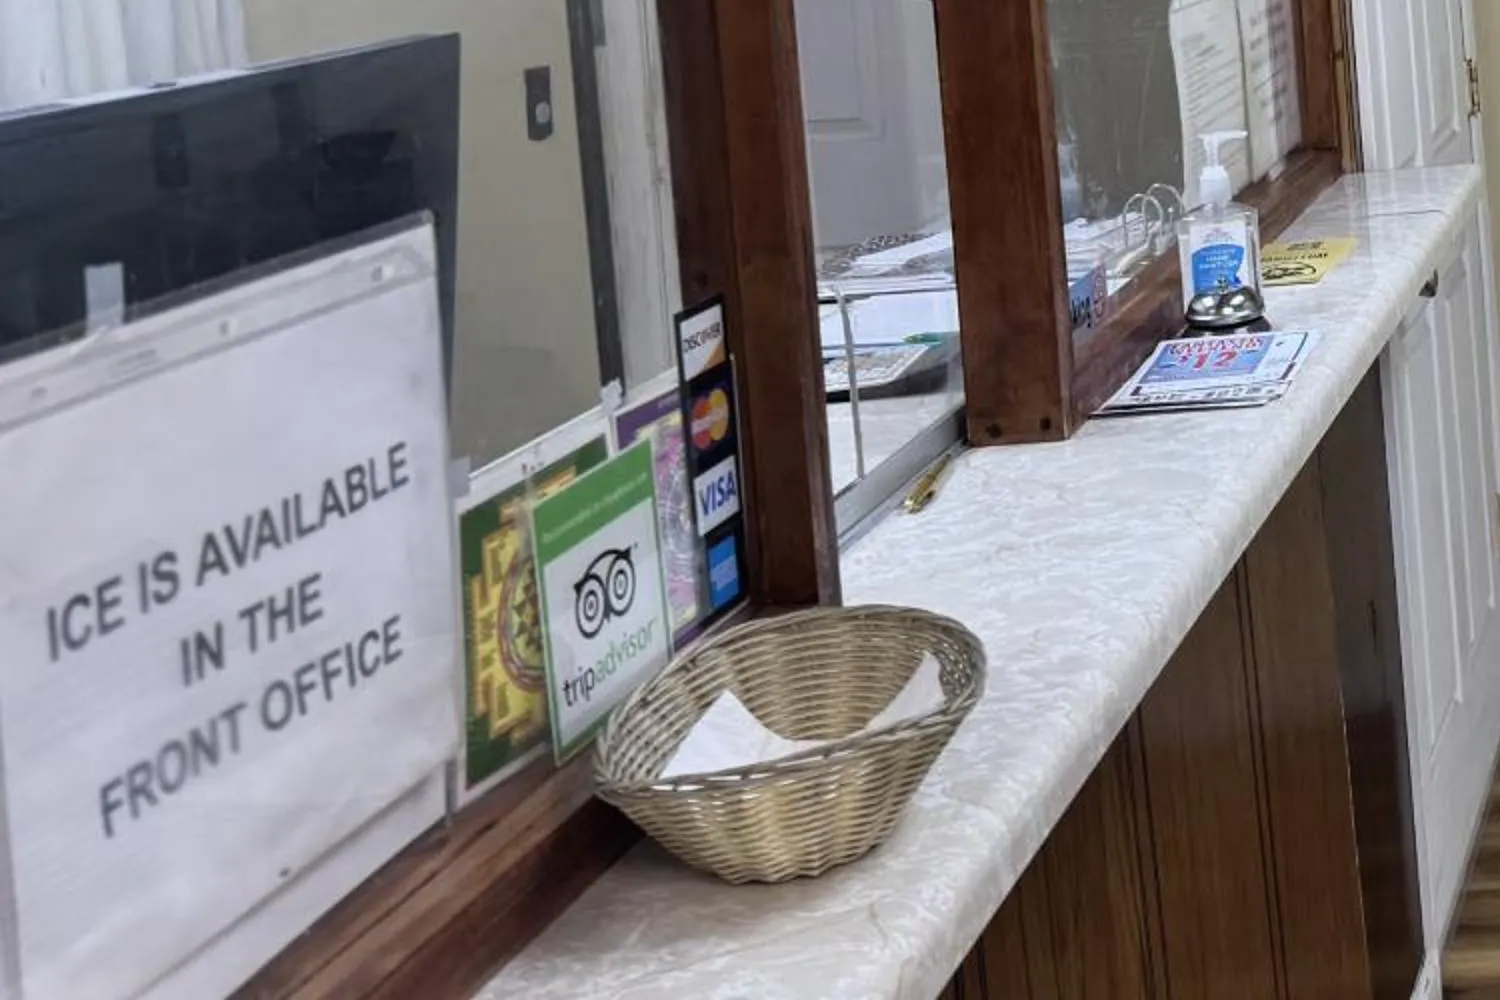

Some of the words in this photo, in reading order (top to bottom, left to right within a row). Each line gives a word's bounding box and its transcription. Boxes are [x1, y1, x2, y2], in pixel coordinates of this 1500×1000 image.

[700, 469, 737, 517] VISA
[46, 575, 126, 663] ICE
[137, 549, 181, 615] IS
[195, 441, 410, 587] AVAILABLE
[179, 620, 226, 688] IN
[237, 571, 325, 654] THE
[562, 617, 657, 708] tripadvisor
[99, 700, 249, 839] FRONT
[259, 613, 404, 733] OFFICE
